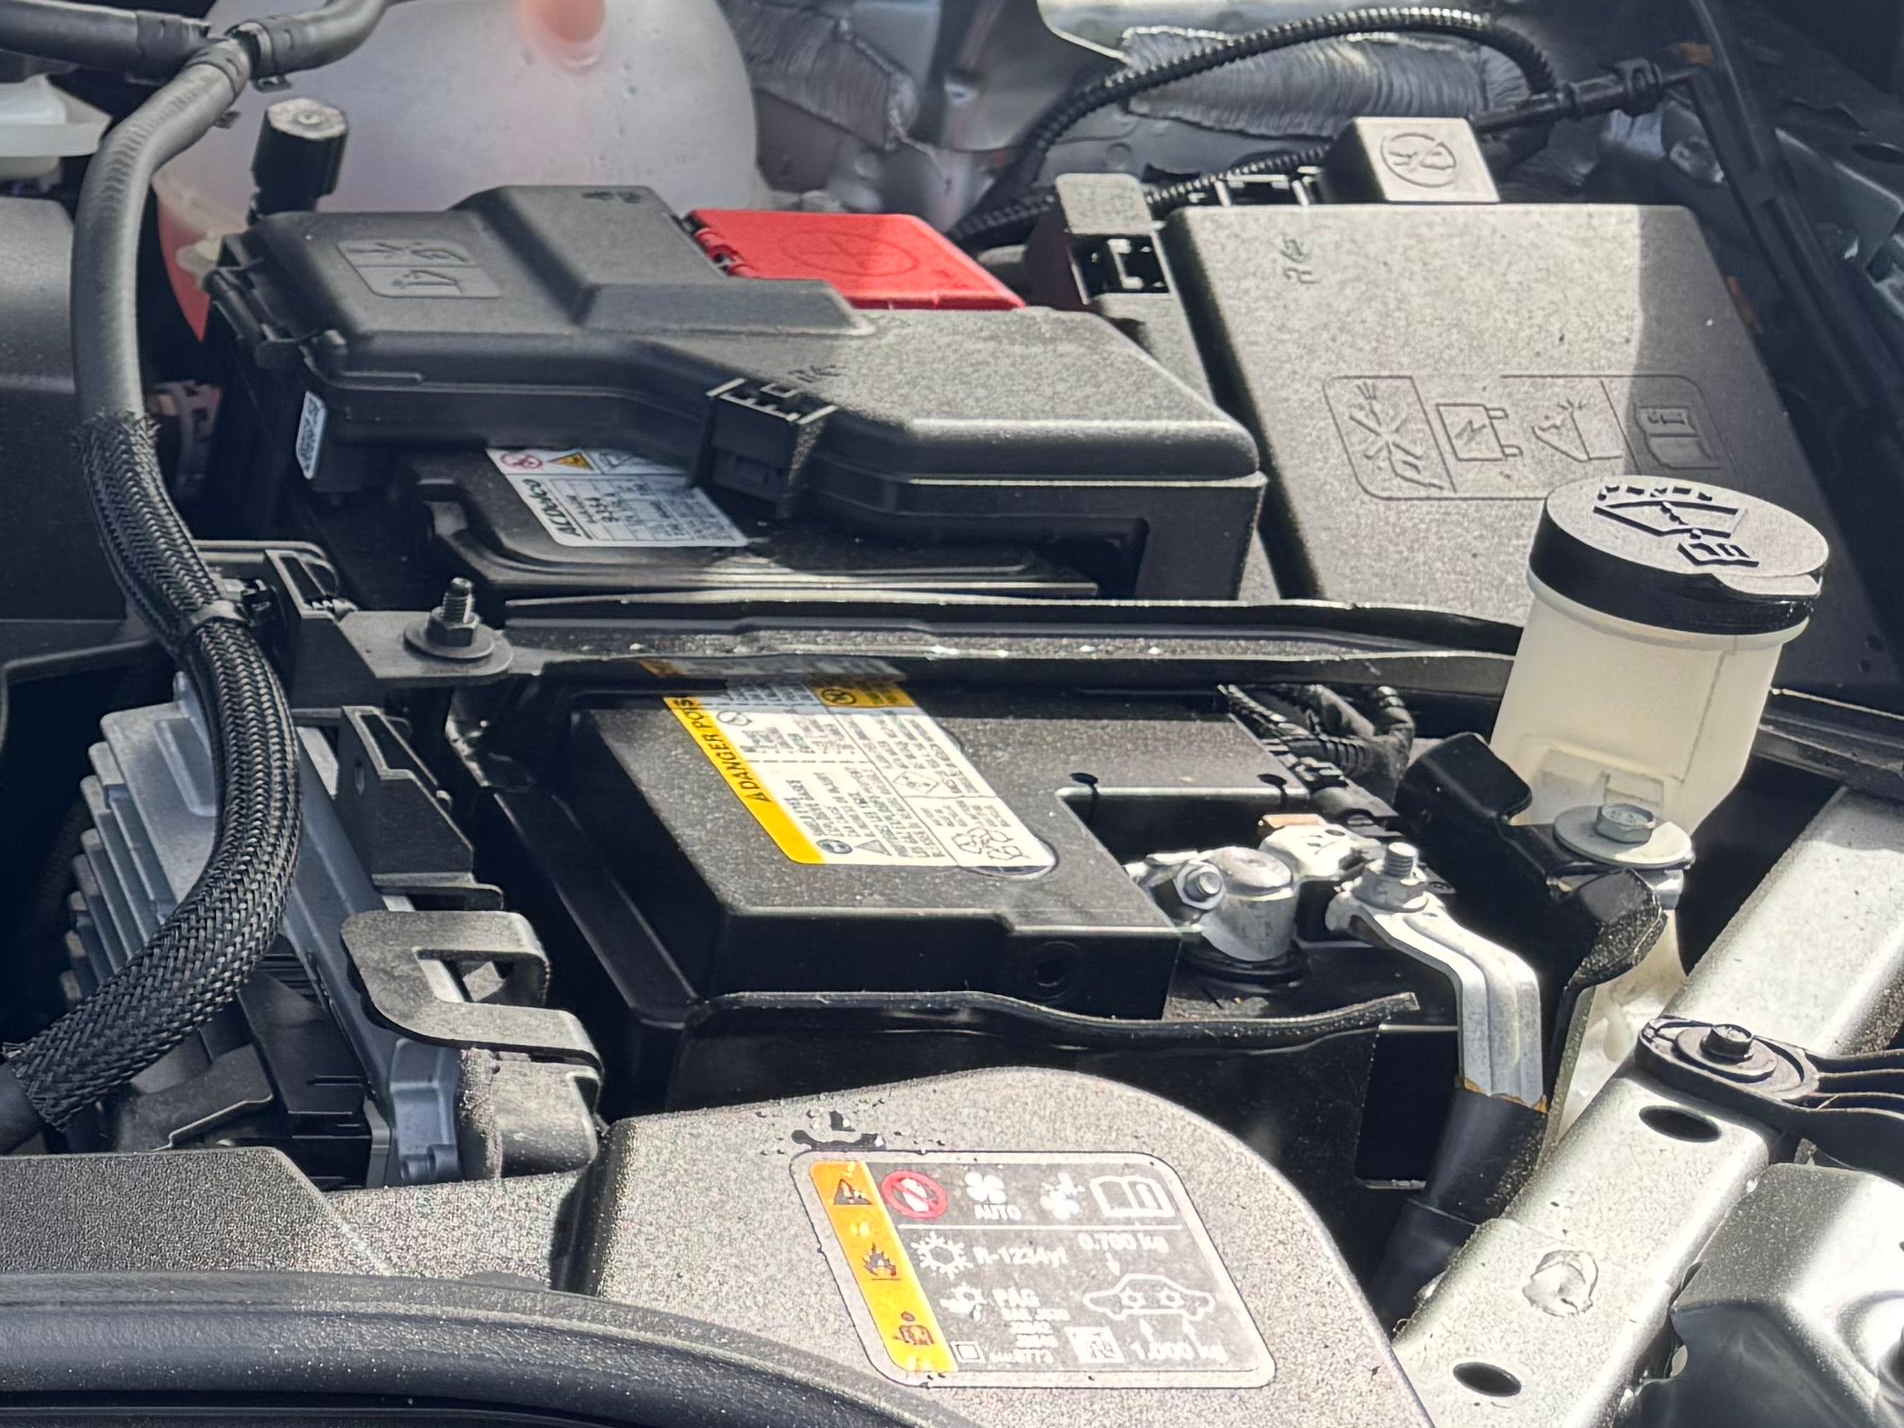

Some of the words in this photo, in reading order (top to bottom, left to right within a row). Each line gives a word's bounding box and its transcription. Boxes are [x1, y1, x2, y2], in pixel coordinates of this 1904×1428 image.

[522, 478, 582, 537] ACDelco
[701, 732, 761, 794] DANGER
[974, 1204, 1023, 1221] AUTO
